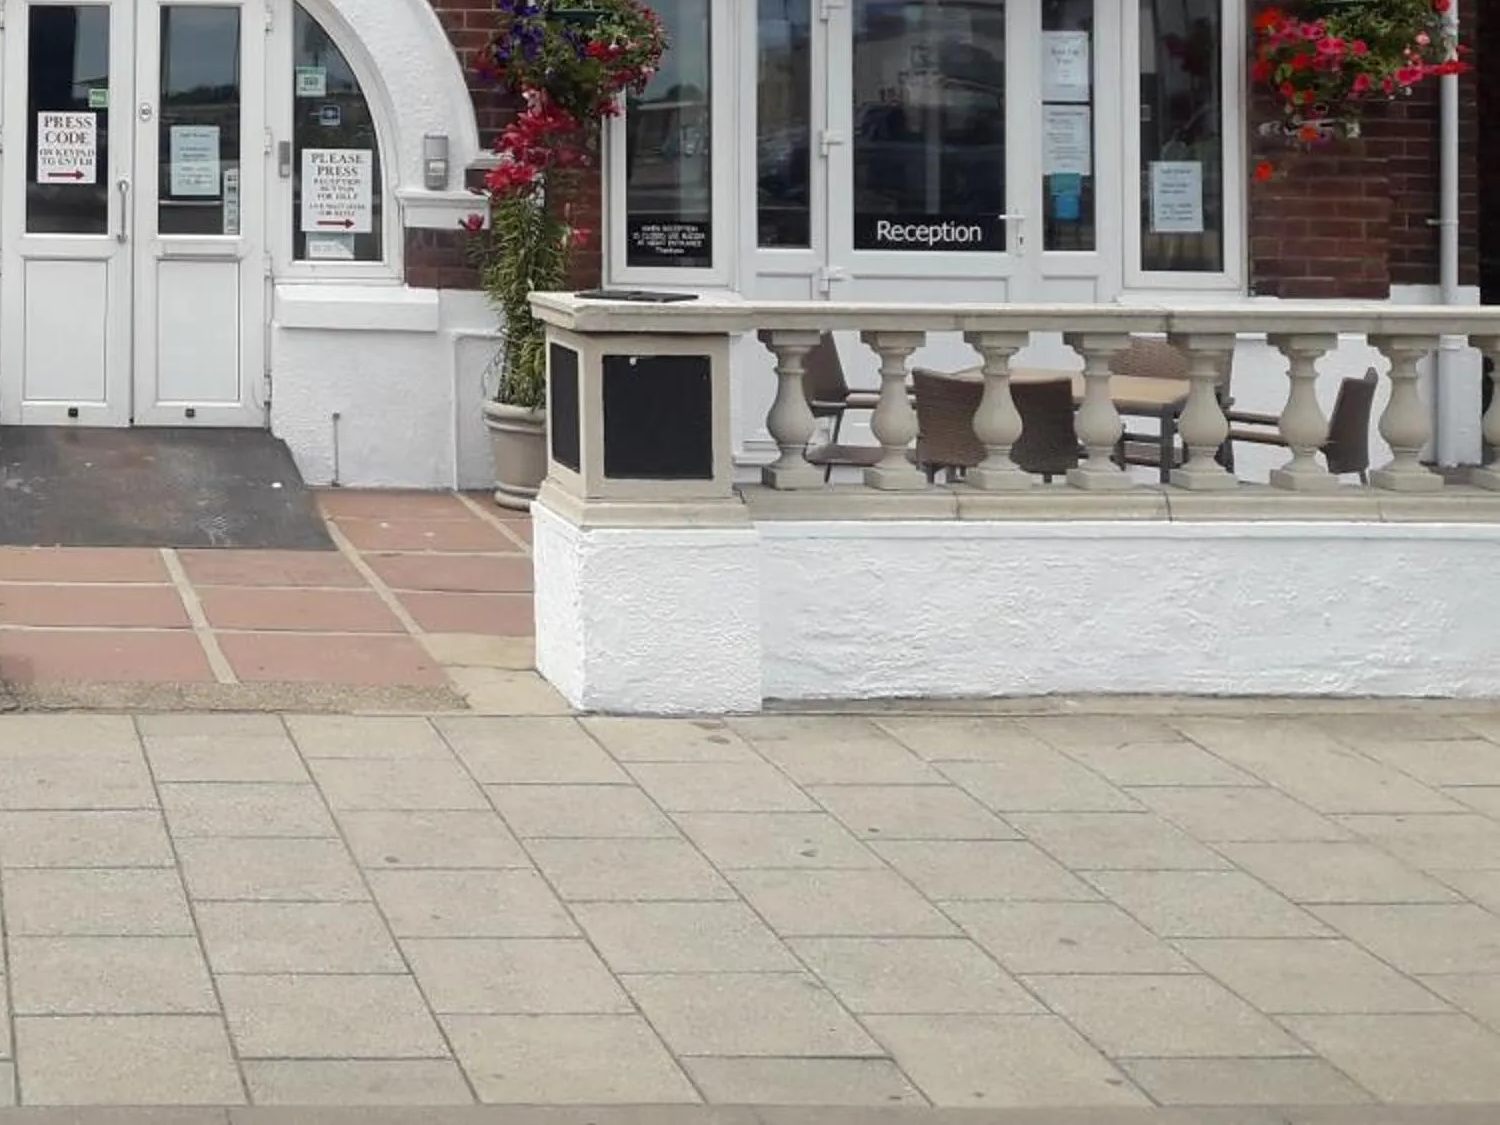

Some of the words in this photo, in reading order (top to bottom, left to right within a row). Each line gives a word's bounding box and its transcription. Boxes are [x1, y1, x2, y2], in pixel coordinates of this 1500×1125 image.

[44, 116, 92, 128] PRESS
[45, 131, 89, 144] CODE
[310, 153, 365, 164] PLEASE
[317, 165, 358, 176] PRESS
[877, 220, 982, 246] Reception
